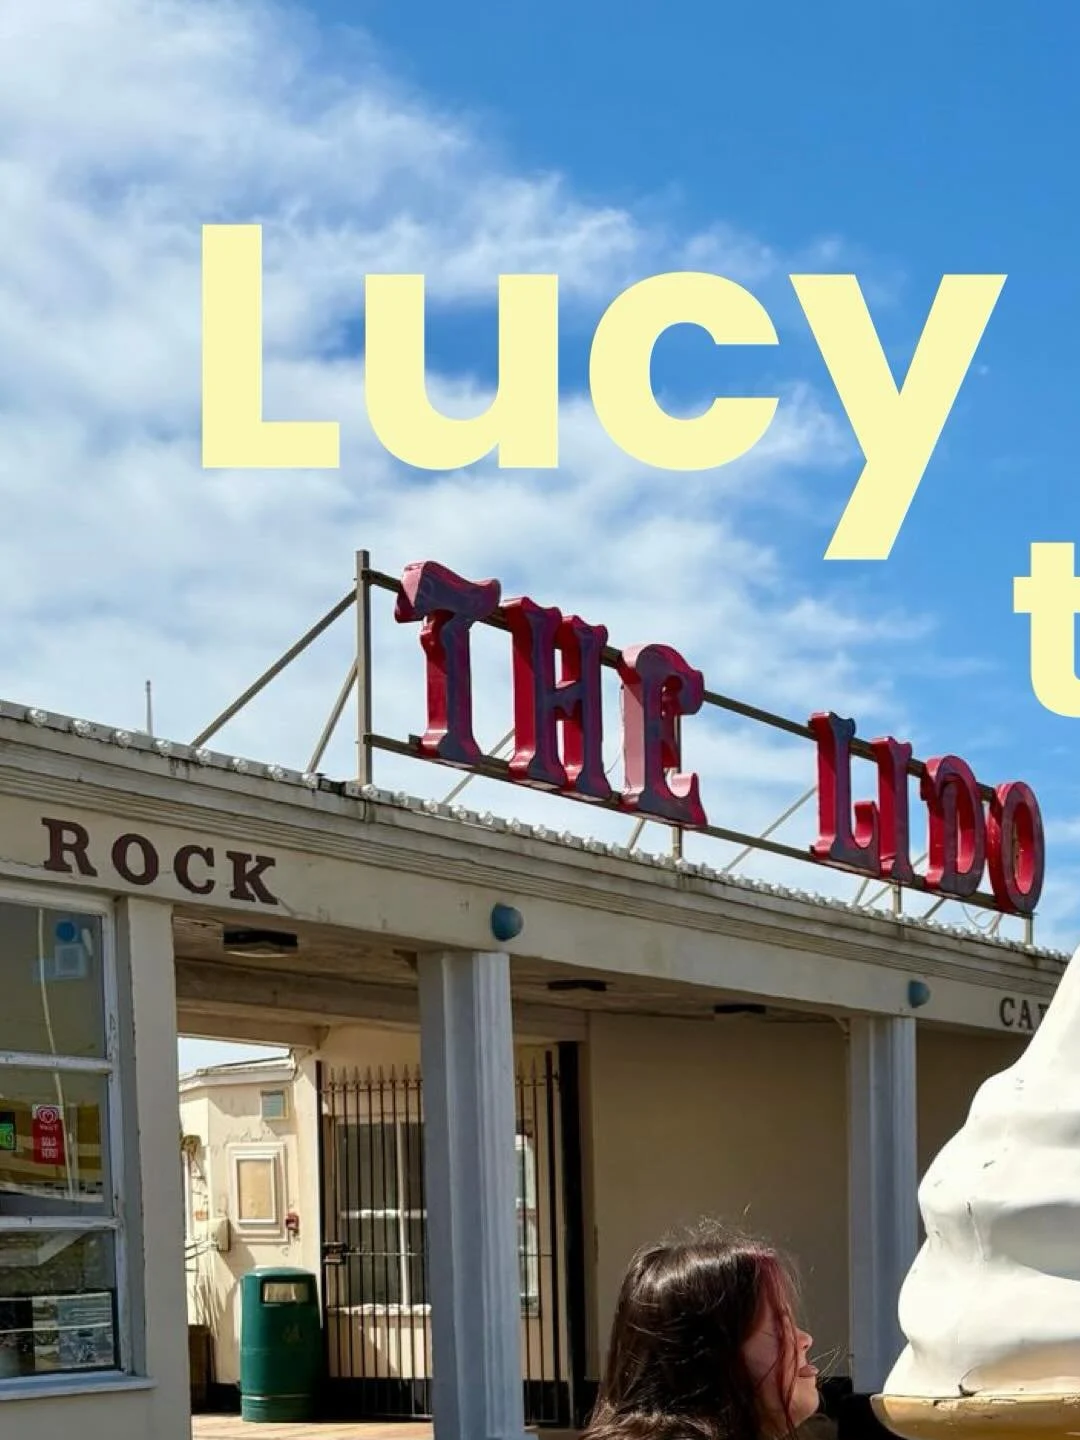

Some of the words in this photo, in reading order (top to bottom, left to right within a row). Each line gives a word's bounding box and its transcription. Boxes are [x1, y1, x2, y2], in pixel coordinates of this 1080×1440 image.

[395, 560, 707, 829] THE
[808, 711, 1045, 913] LIDO
[41, 817, 278, 905] ROCK
